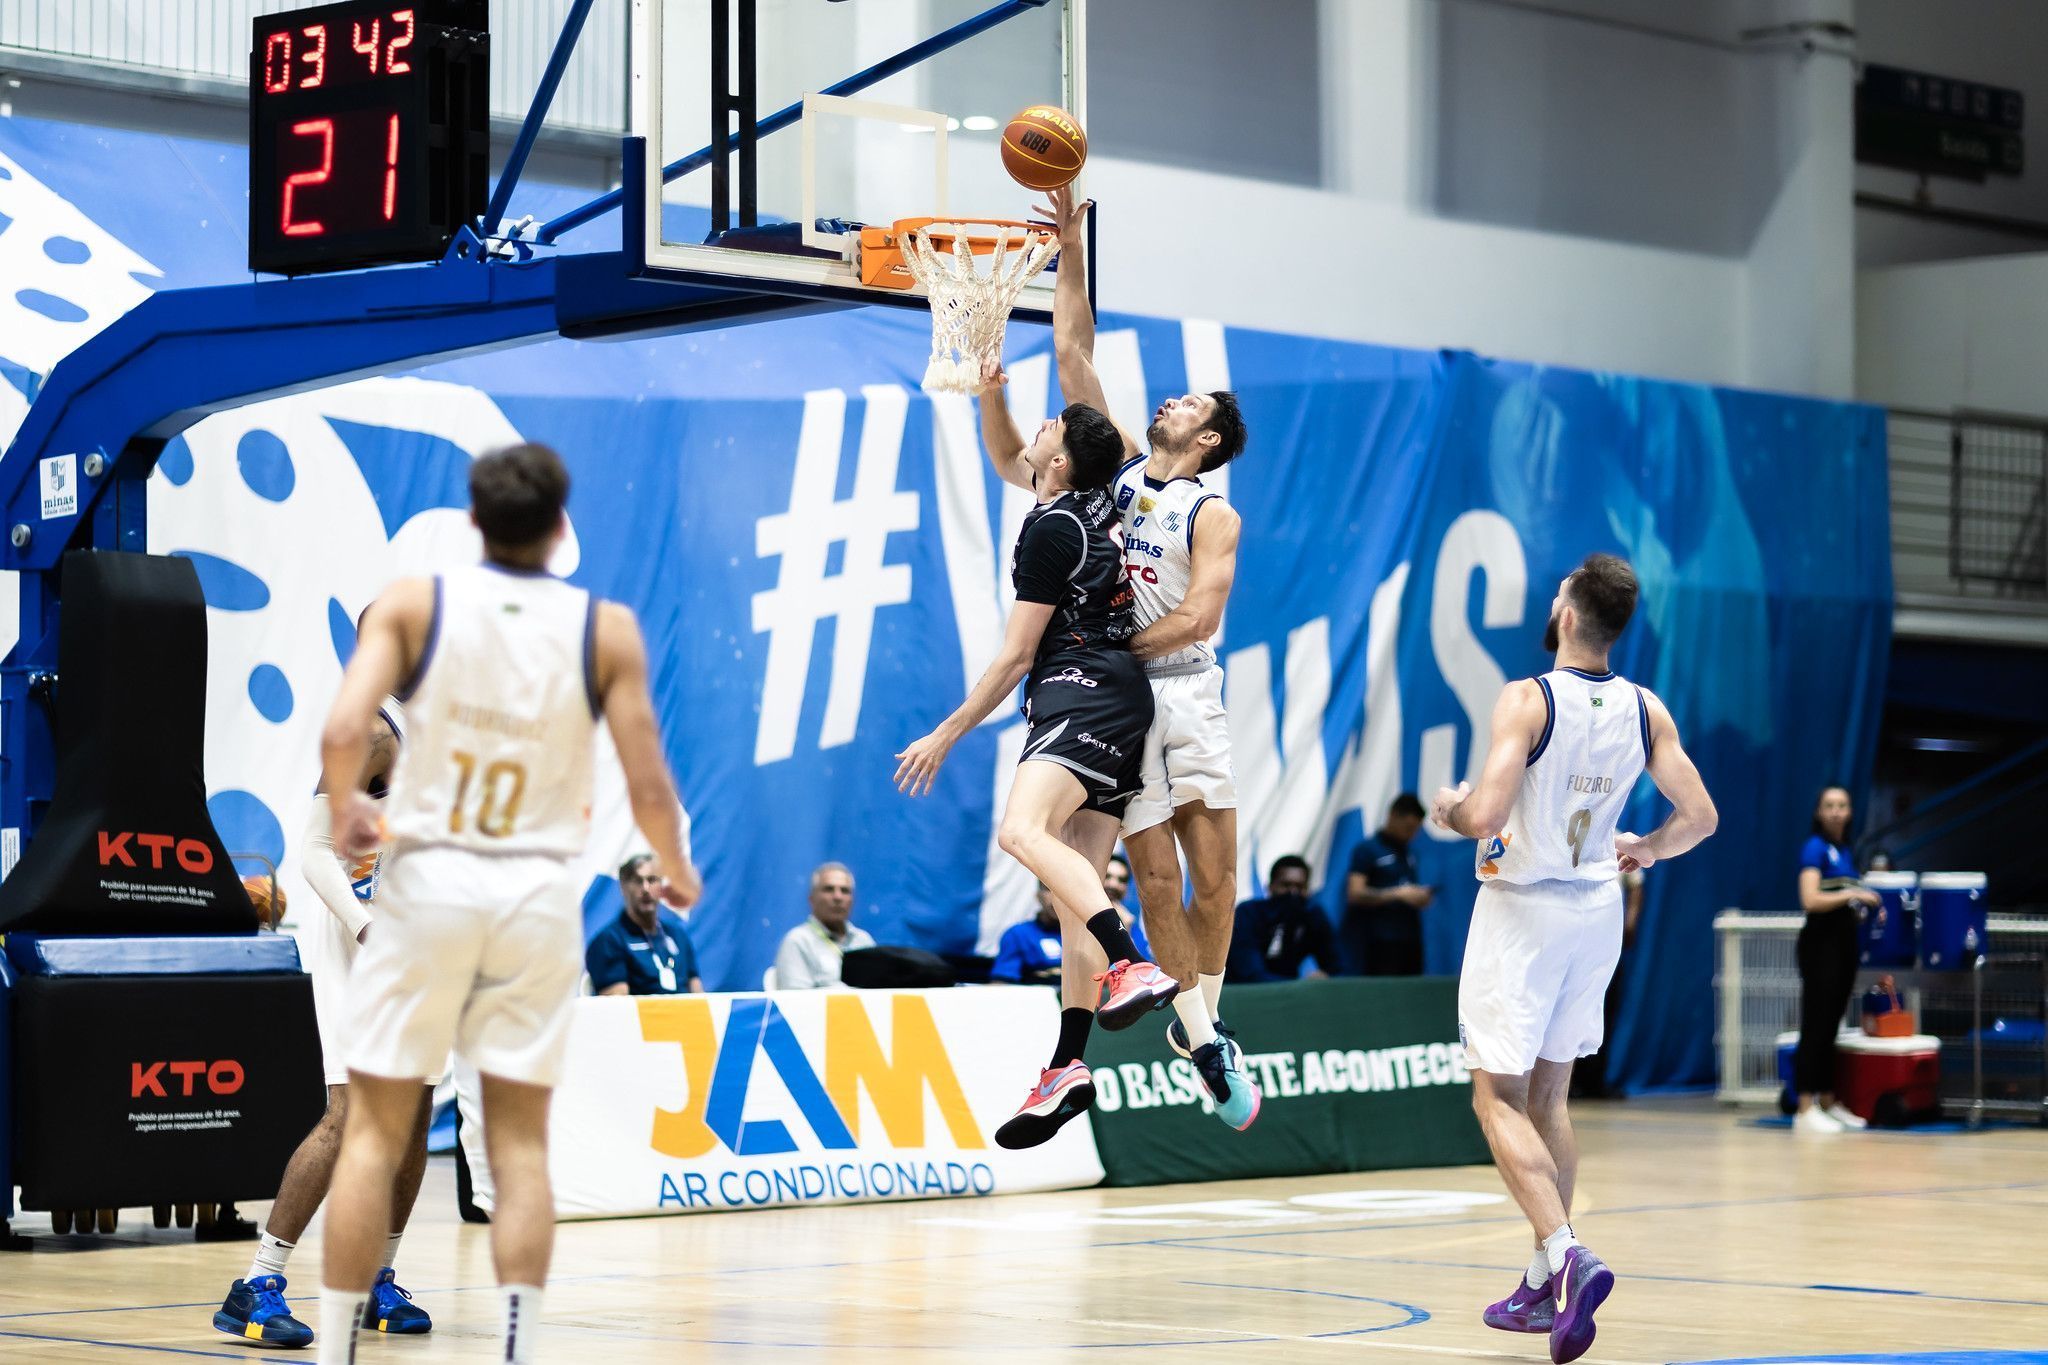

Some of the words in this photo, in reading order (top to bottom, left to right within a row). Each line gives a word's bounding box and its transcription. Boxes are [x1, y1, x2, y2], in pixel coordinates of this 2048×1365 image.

[265, 24, 326, 94] 03
[353, 9, 414, 74] 42
[1021, 108, 1081, 141] PENALTY
[281, 112, 399, 236] 21
[44, 495, 74, 509] minas
[1125, 532, 1164, 559] inas
[1126, 564, 1159, 585] TO
[449, 750, 528, 839] 10
[1567, 774, 1613, 794] FUZIRO
[97, 831, 214, 874] KTO
[1567, 808, 1592, 869] 9
[108, 890, 131, 901] Jogue
[131, 893, 146, 901] com
[130, 882, 146, 892] para
[178, 886, 188, 895] de
[188, 886, 197, 896] 18
[131, 1059, 245, 1098] KTO
[636, 994, 988, 1159] JAM
[1122, 1051, 1301, 1114] BASETE
[1303, 1042, 1472, 1096] ACONTECE
[157, 1113, 174, 1123] para
[204, 1110, 214, 1119] de
[157, 1121, 174, 1131] com
[657, 1170, 708, 1208] AR
[718, 1161, 995, 1206] CONDICIONADO
